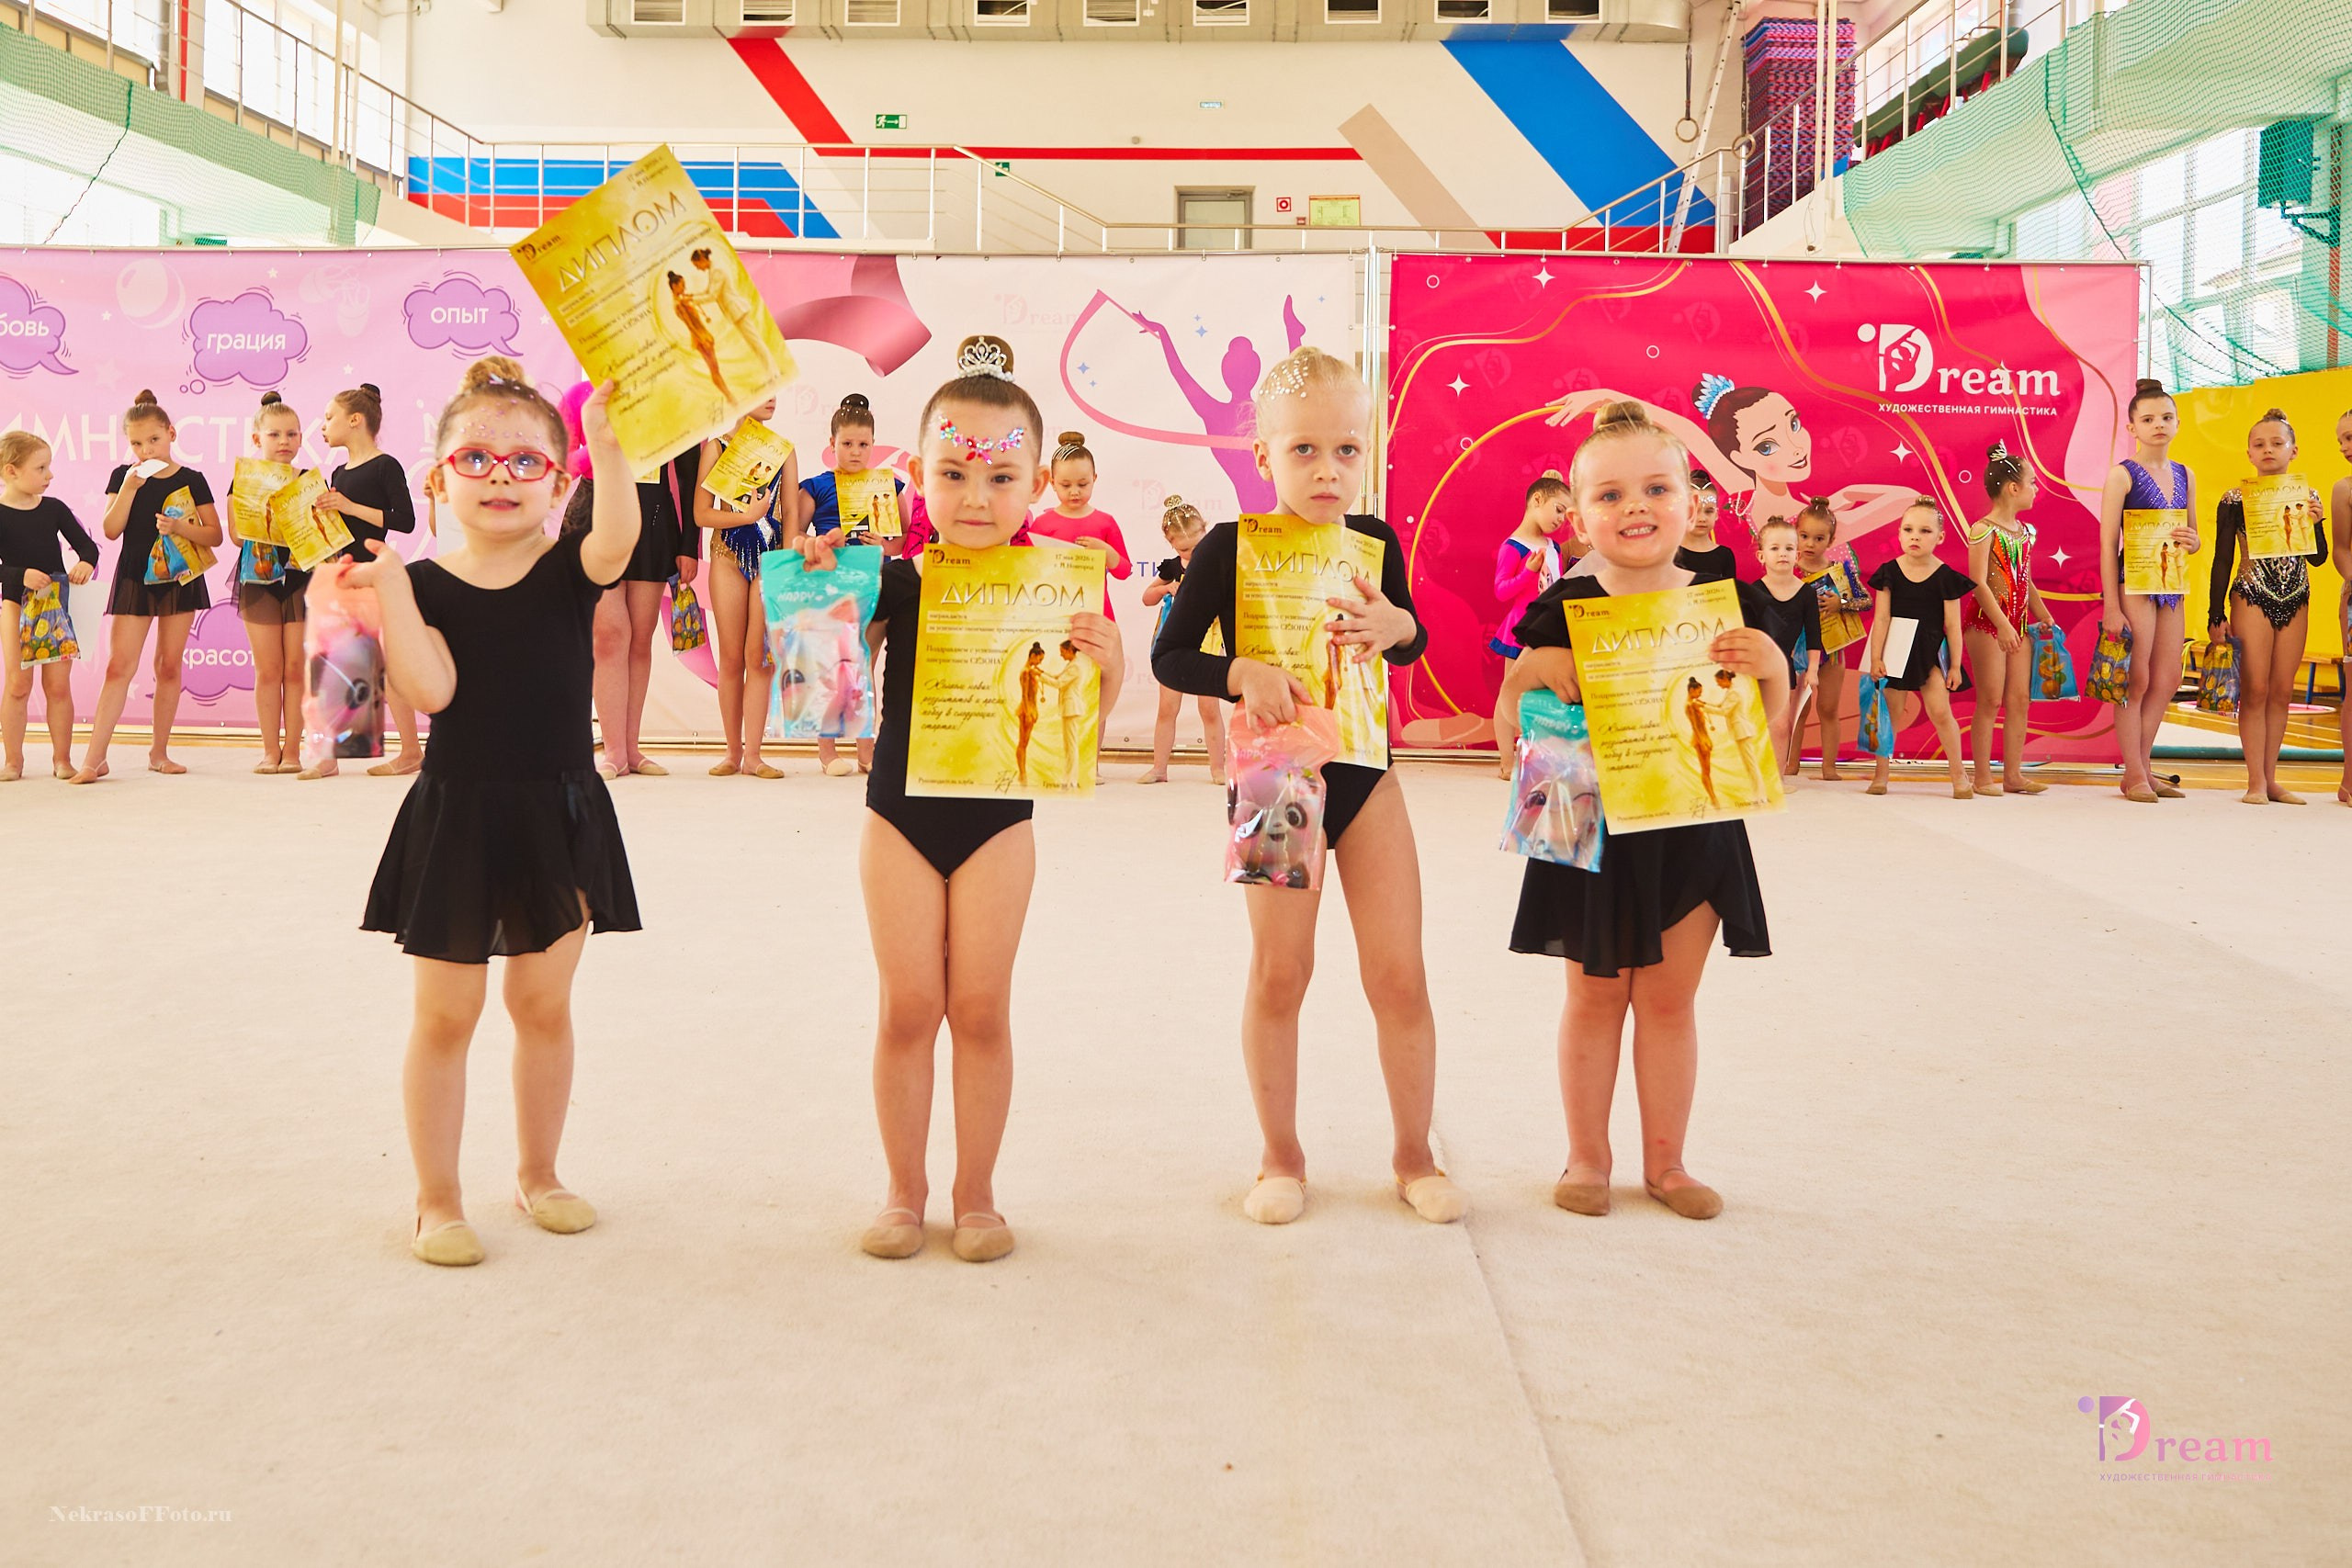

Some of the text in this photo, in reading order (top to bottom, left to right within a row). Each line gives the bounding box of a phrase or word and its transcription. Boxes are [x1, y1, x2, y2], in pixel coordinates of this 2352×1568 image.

[556, 191, 687, 293] ДИПЛОМ
[207, 333, 286, 355] грация
[1858, 323, 2061, 396] Dream
[1878, 403, 2057, 416] ХУДОЖЕСТВЕННАЯ ГИМНАСТИКА
[1243, 518, 1282, 534] Dream
[929, 549, 971, 565] Dream
[941, 581, 1085, 608] ДИПЛОМ
[1568, 604, 1610, 618] Dream
[1591, 616, 1725, 654] ДИПЛОМ
